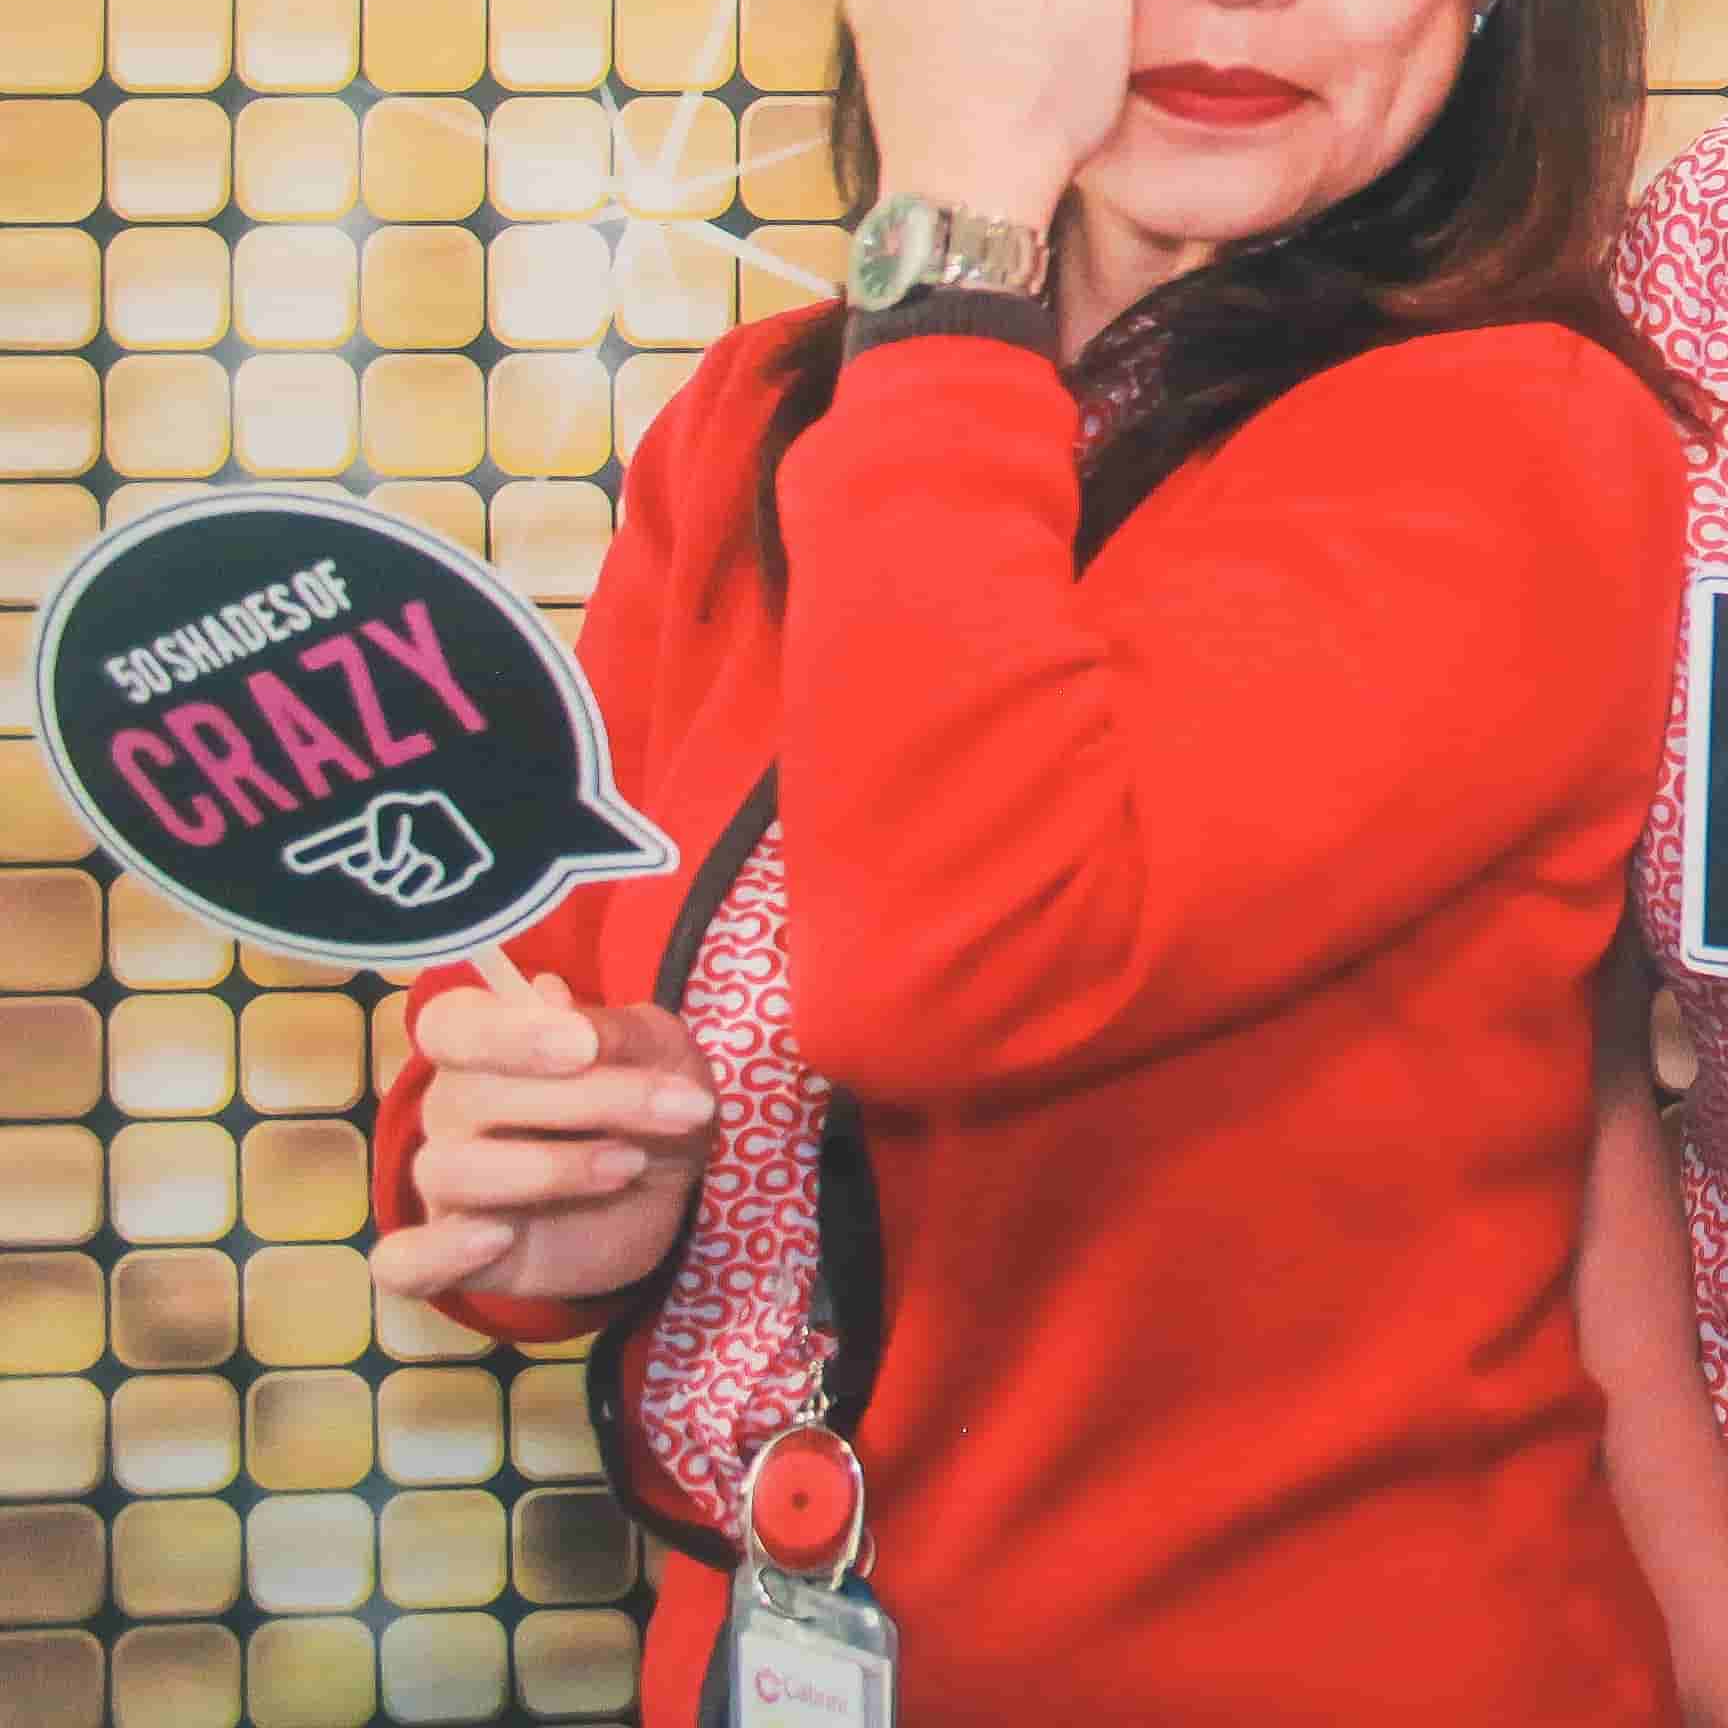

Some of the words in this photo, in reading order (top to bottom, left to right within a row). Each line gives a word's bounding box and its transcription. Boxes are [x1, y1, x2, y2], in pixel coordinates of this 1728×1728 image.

[104, 647, 173, 704] 50
[153, 582, 312, 683] SHADES
[291, 558, 352, 620] OF
[110, 599, 488, 847] CRAZY
